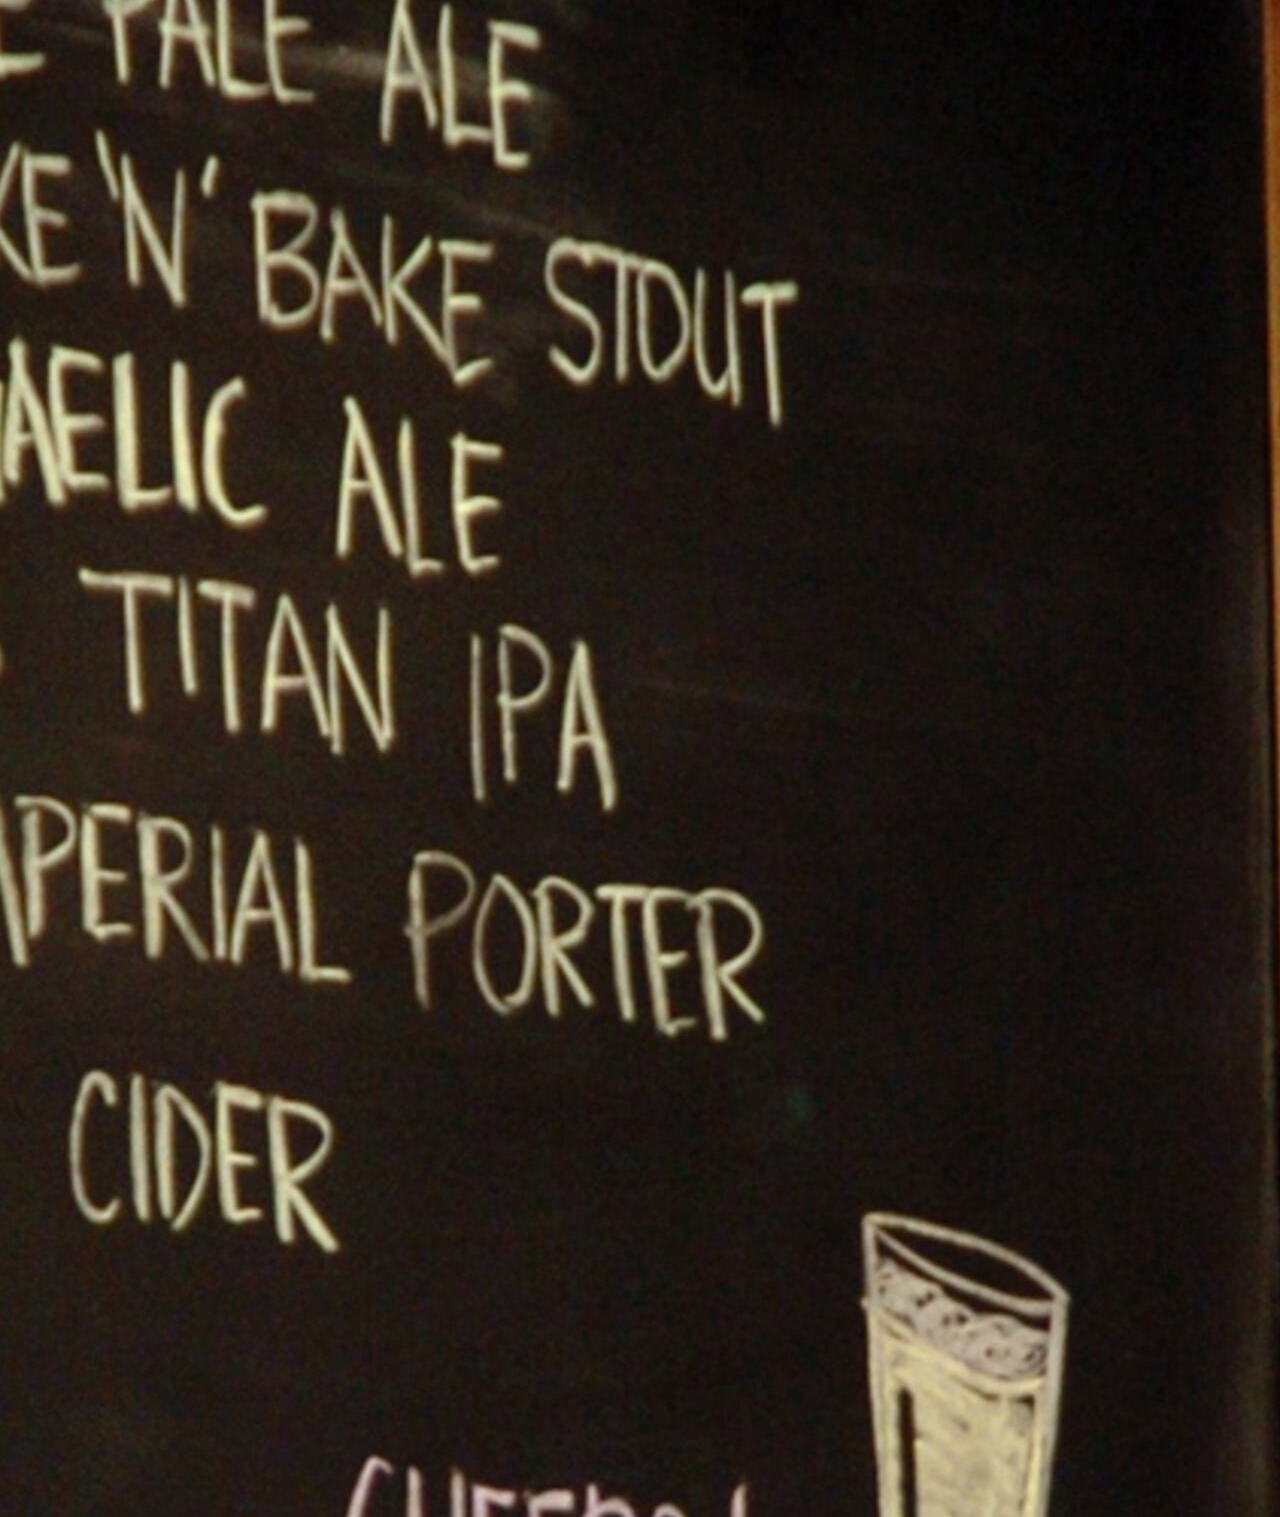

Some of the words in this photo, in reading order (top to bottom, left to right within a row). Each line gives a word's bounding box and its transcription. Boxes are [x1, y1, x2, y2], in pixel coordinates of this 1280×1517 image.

[250, 191, 493, 387] BAKE
[545, 237, 798, 426] STOUT
[336, 396, 503, 577] ALE
[78, 567, 396, 755] TITAN
[470, 624, 617, 811] IPA
[405, 850, 764, 1041] PORTER
[69, 1070, 340, 1253] CIDER
